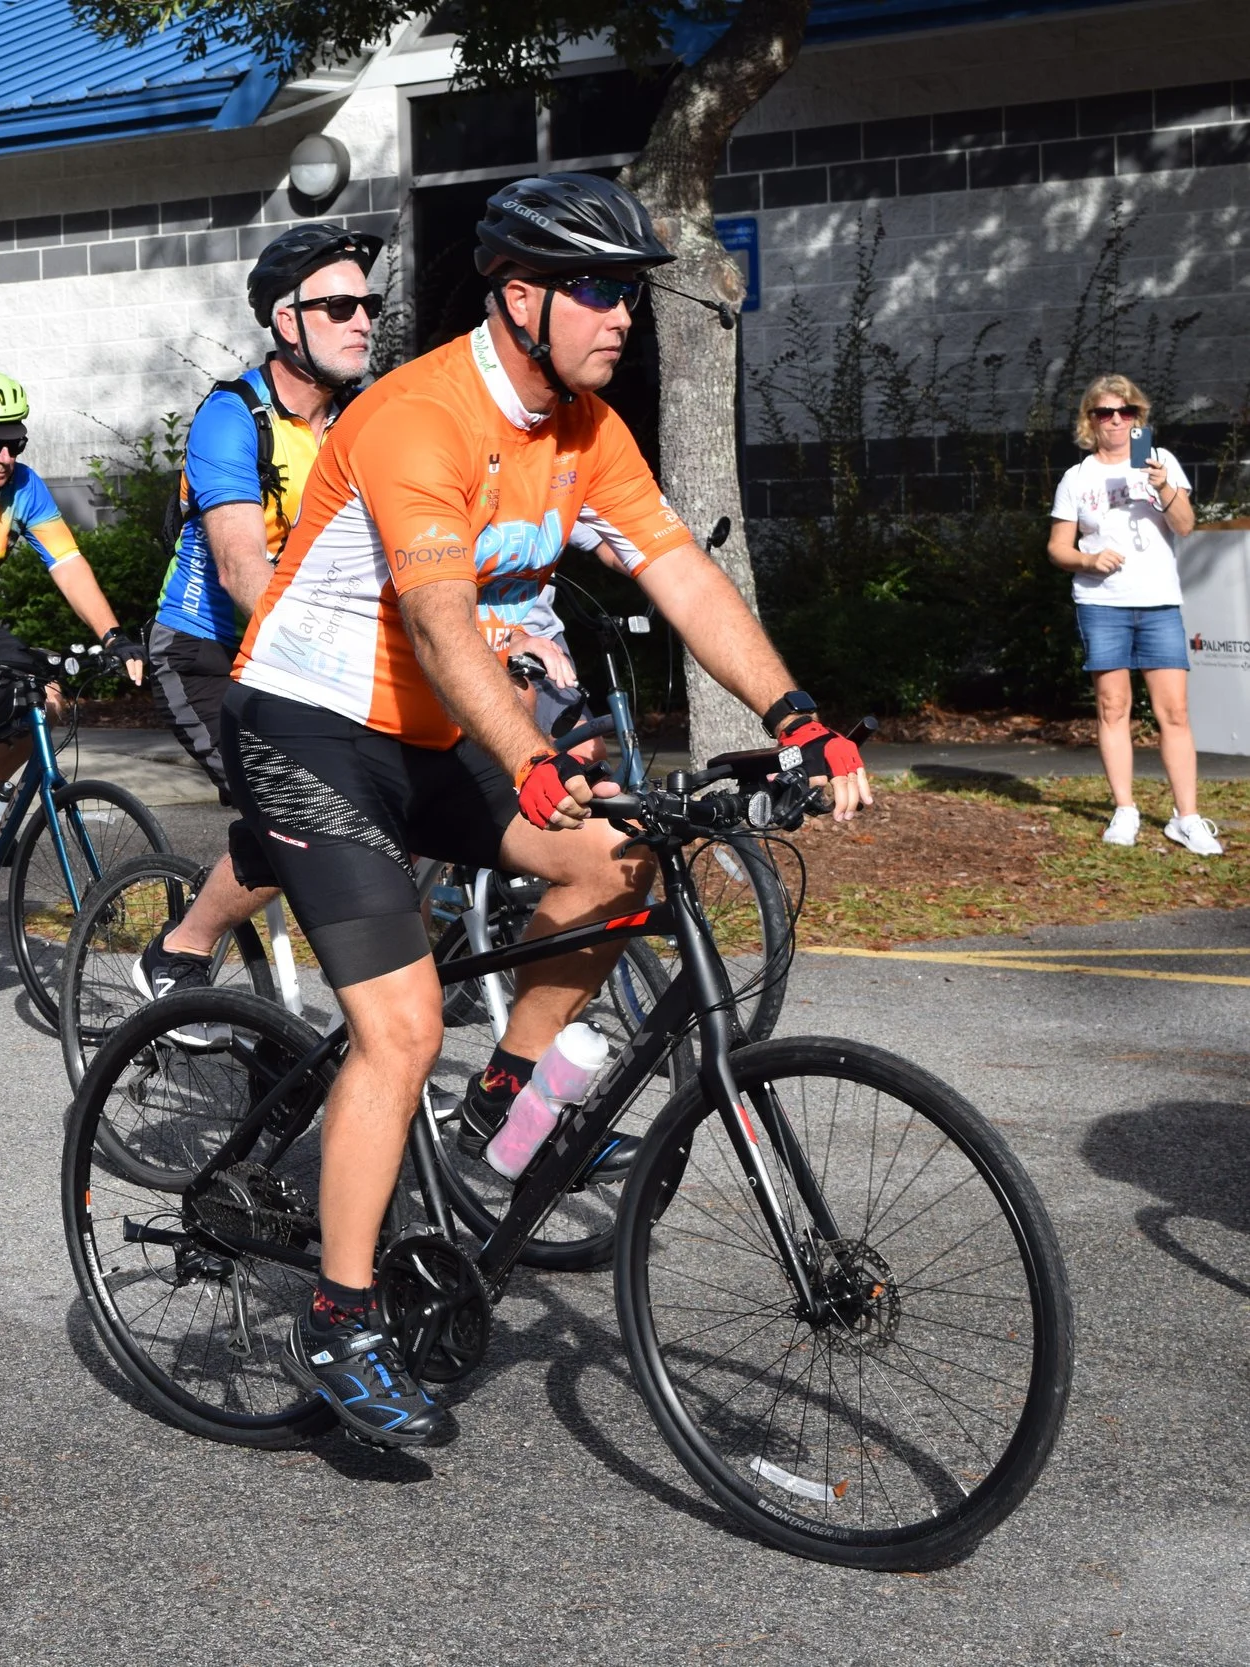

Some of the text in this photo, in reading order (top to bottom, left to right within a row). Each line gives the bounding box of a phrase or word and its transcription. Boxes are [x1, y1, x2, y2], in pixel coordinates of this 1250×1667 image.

[514, 204, 550, 228] GIRO
[394, 544, 468, 572] Drayer
[554, 1022, 654, 1158] TREK
[764, 1505, 834, 1538] BONTRAGER
